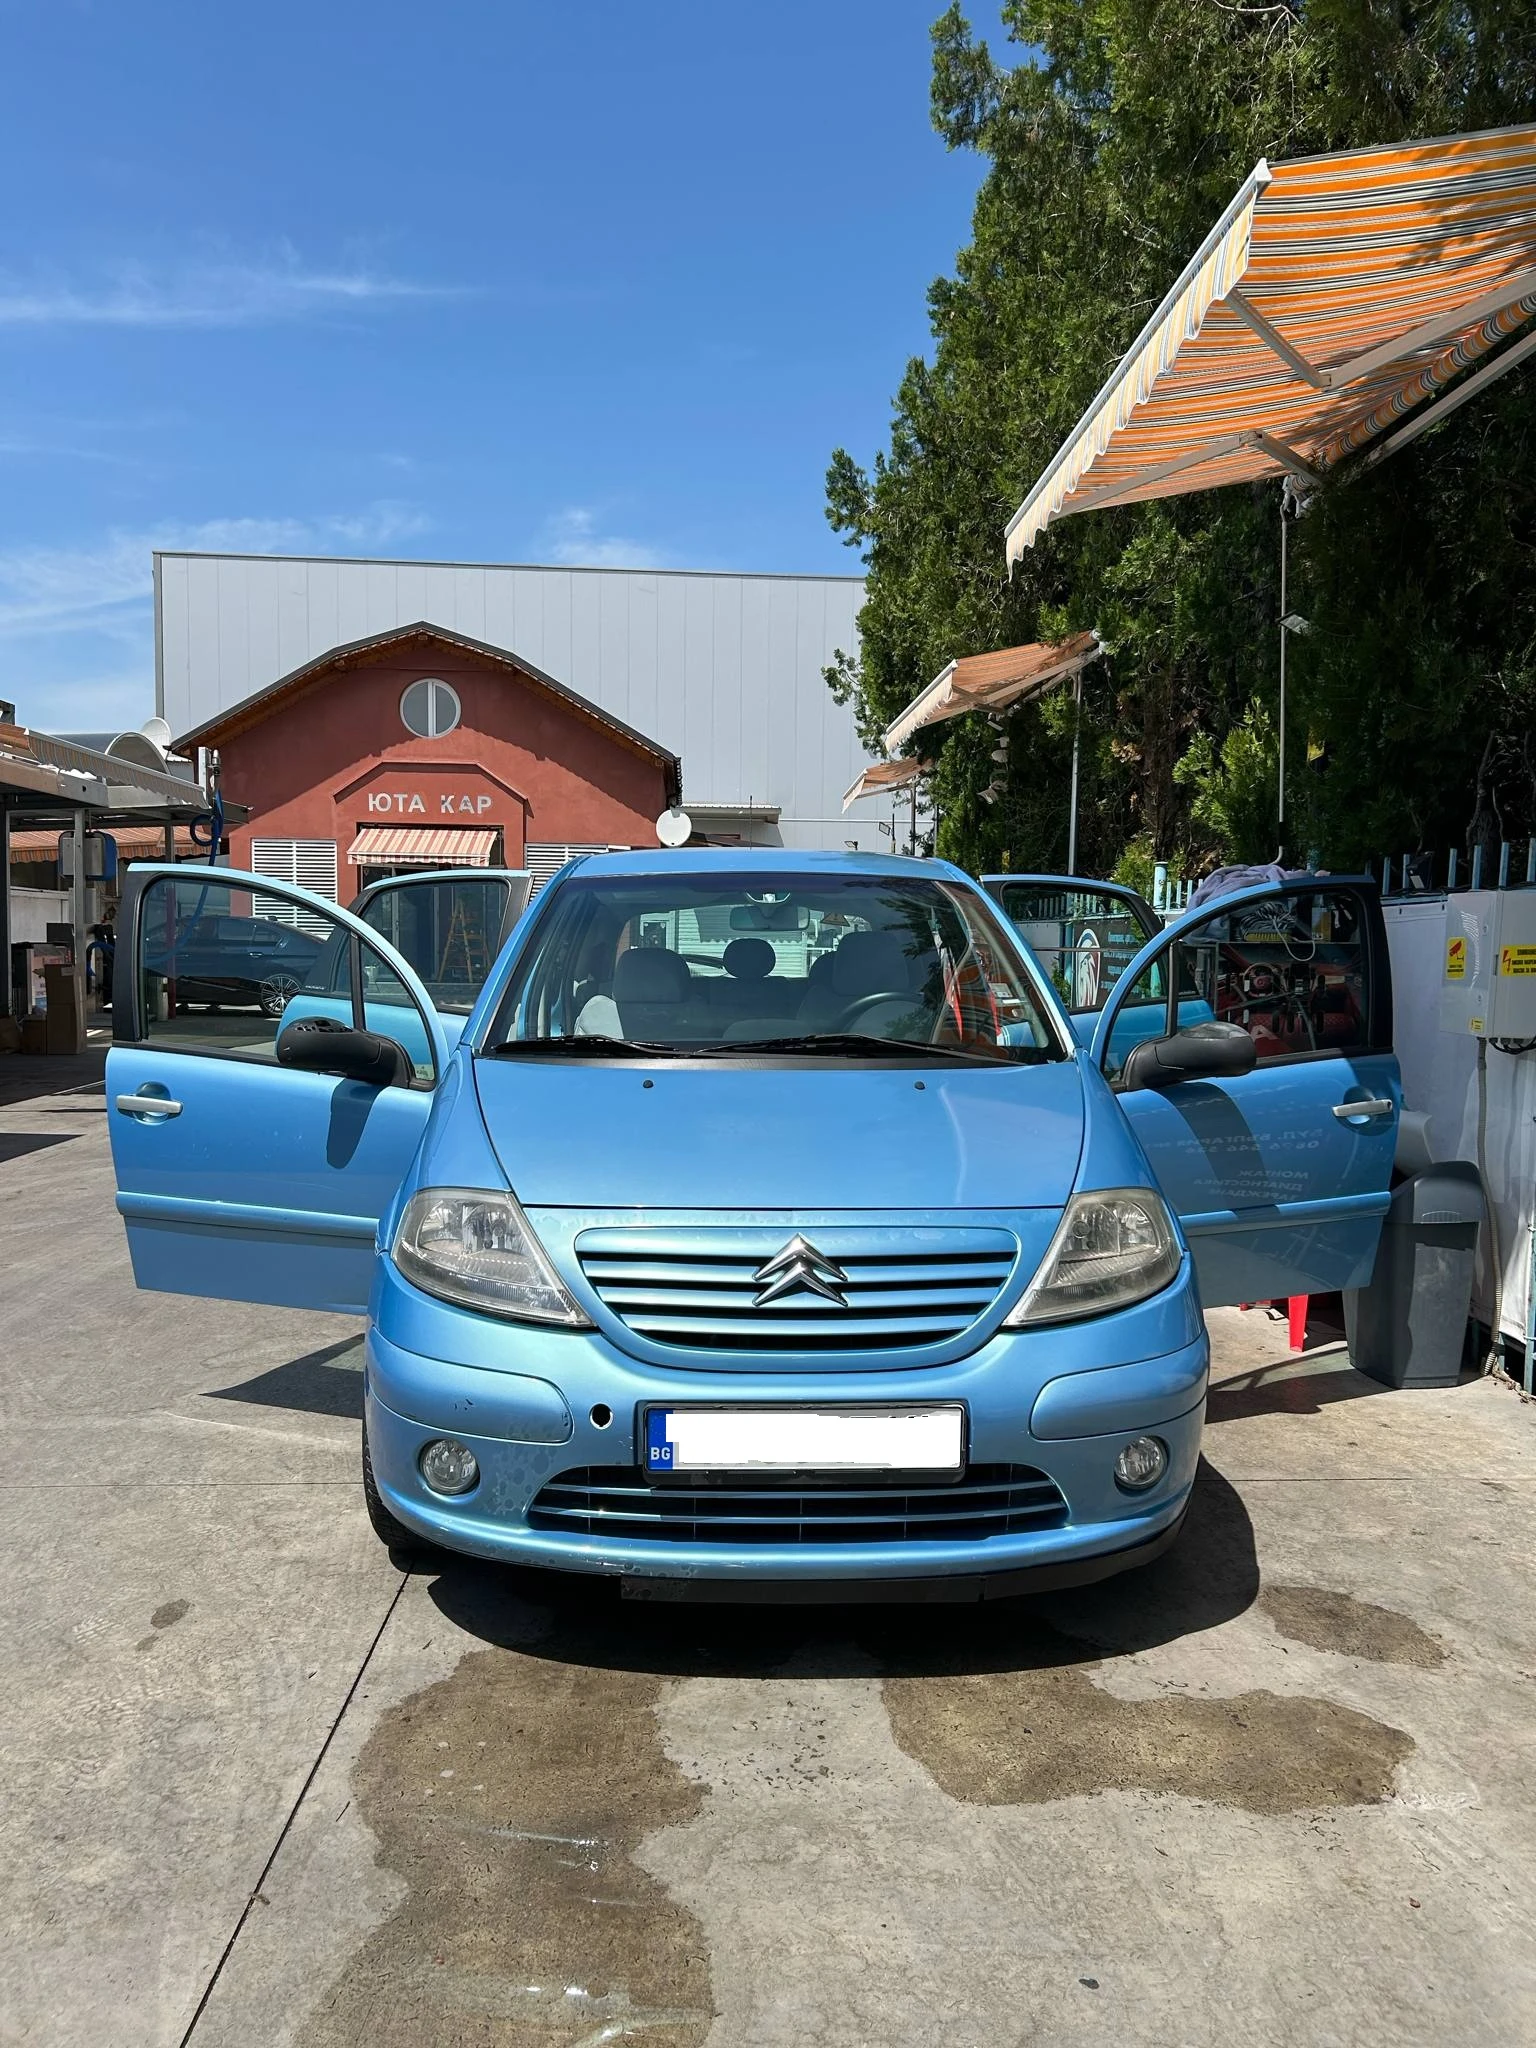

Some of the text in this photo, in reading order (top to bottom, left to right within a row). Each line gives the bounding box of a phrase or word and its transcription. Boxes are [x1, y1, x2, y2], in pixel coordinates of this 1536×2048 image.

[368, 793, 492, 814] ЮТА КАР
[650, 1447, 671, 1460] BG
